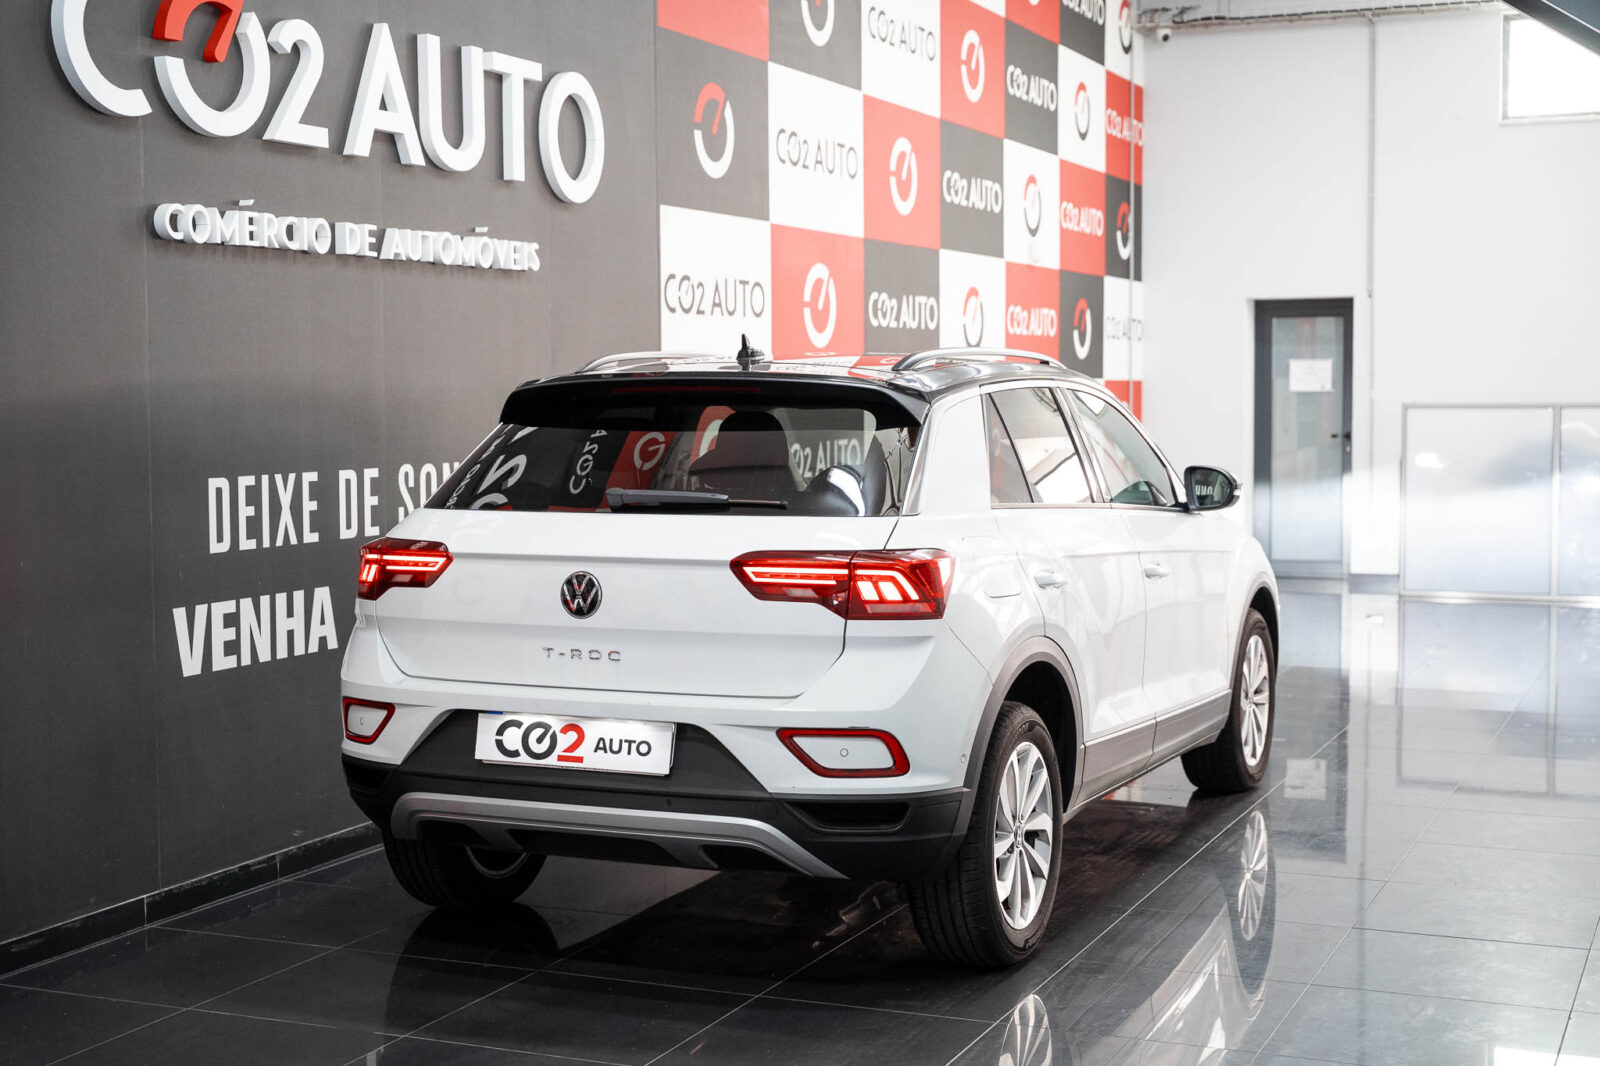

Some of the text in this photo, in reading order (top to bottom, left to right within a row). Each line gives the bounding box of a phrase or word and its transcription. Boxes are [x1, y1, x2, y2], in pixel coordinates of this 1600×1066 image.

[868, 6, 936, 61] CO2 AUTO
[1006, 64, 1058, 112] CO2 AUTO
[343, 22, 605, 203] AUTO
[776, 128, 858, 179] CO2 AUTO
[942, 170, 1003, 214] CO2 AUTO
[153, 199, 540, 273] COMÉRCIO DE AUTOMÓVEIS
[1060, 201, 1105, 238] CO2 AUTO
[664, 273, 766, 319] CO2 AUTO
[868, 291, 938, 330] CO2 AUTO
[1007, 304, 1058, 337] CO2 AUTO
[208, 471, 320, 555] DEIXE
[338, 467, 380, 540] DE
[172, 585, 339, 678] VENHA
[542, 646, 622, 662] T-ROC
[494, 719, 652, 763] CO2 AUTO
